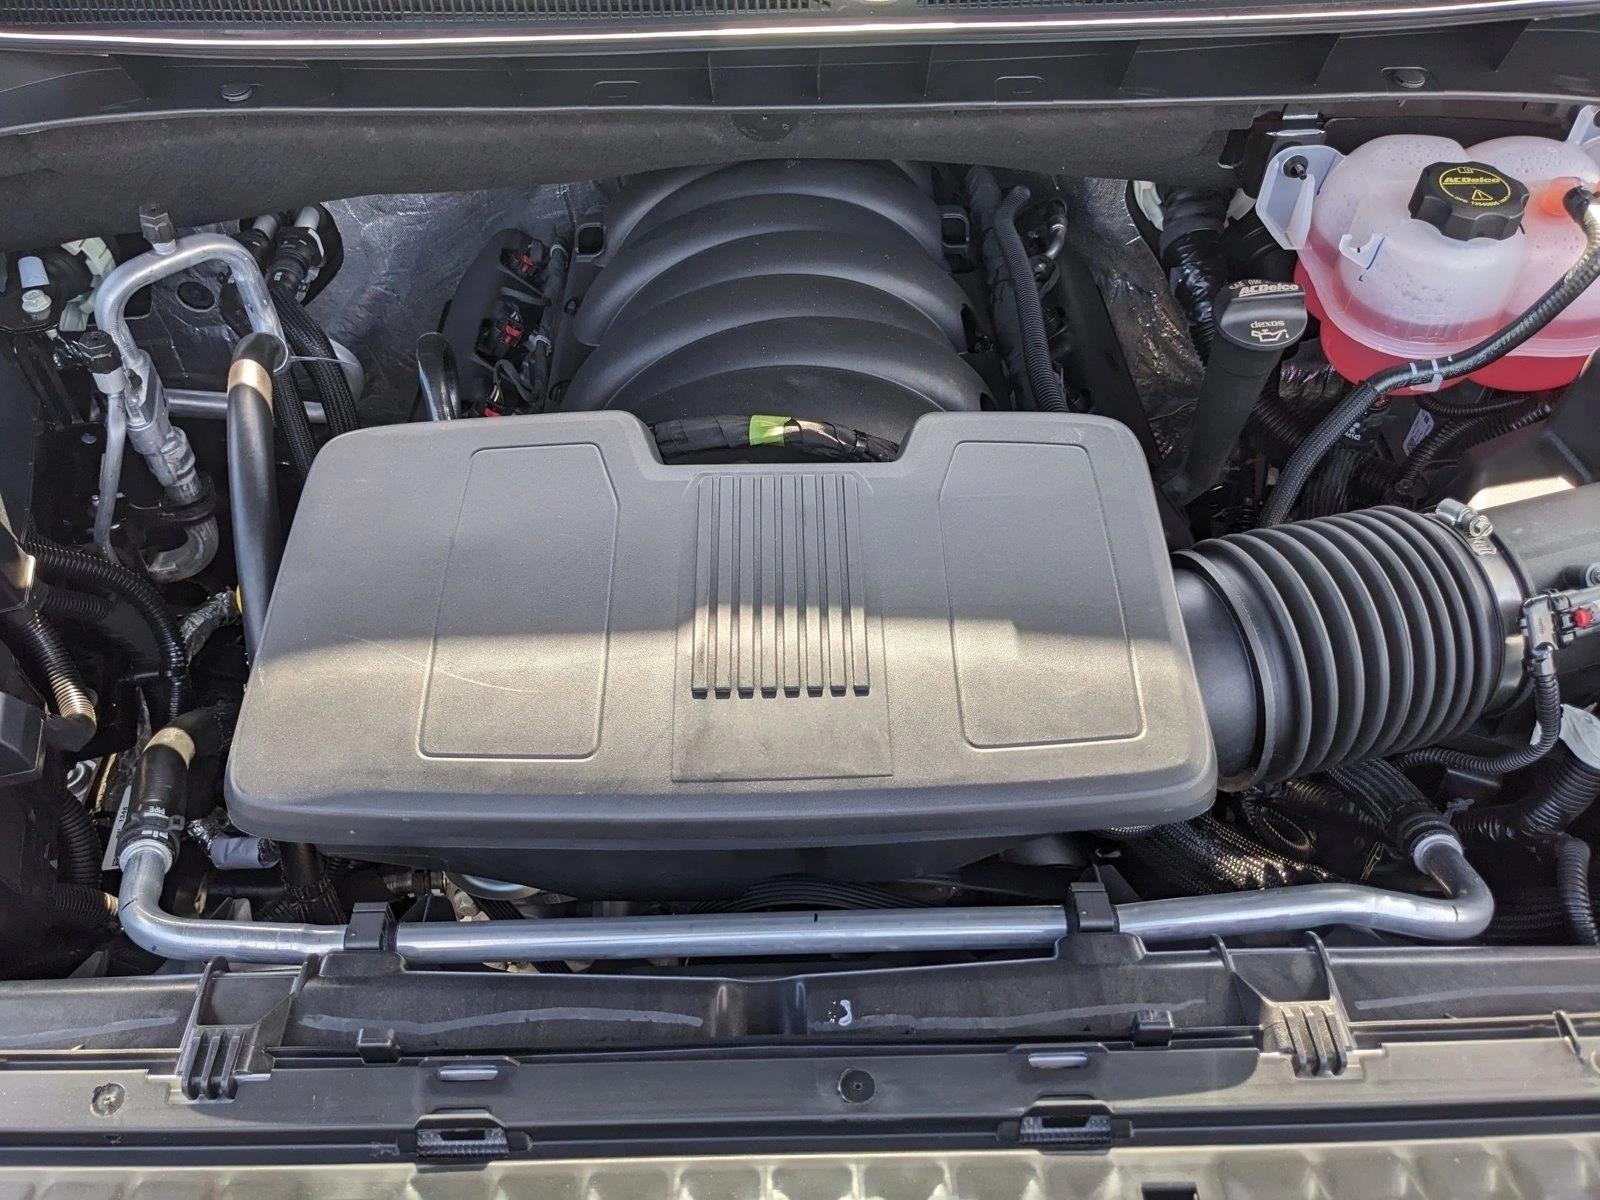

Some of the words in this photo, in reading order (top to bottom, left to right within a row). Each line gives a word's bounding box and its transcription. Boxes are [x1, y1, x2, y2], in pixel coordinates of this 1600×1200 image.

[1443, 176, 1501, 184] ACDelco
[1239, 283, 1299, 297] ACDelco
[1250, 320, 1285, 328] dexos
